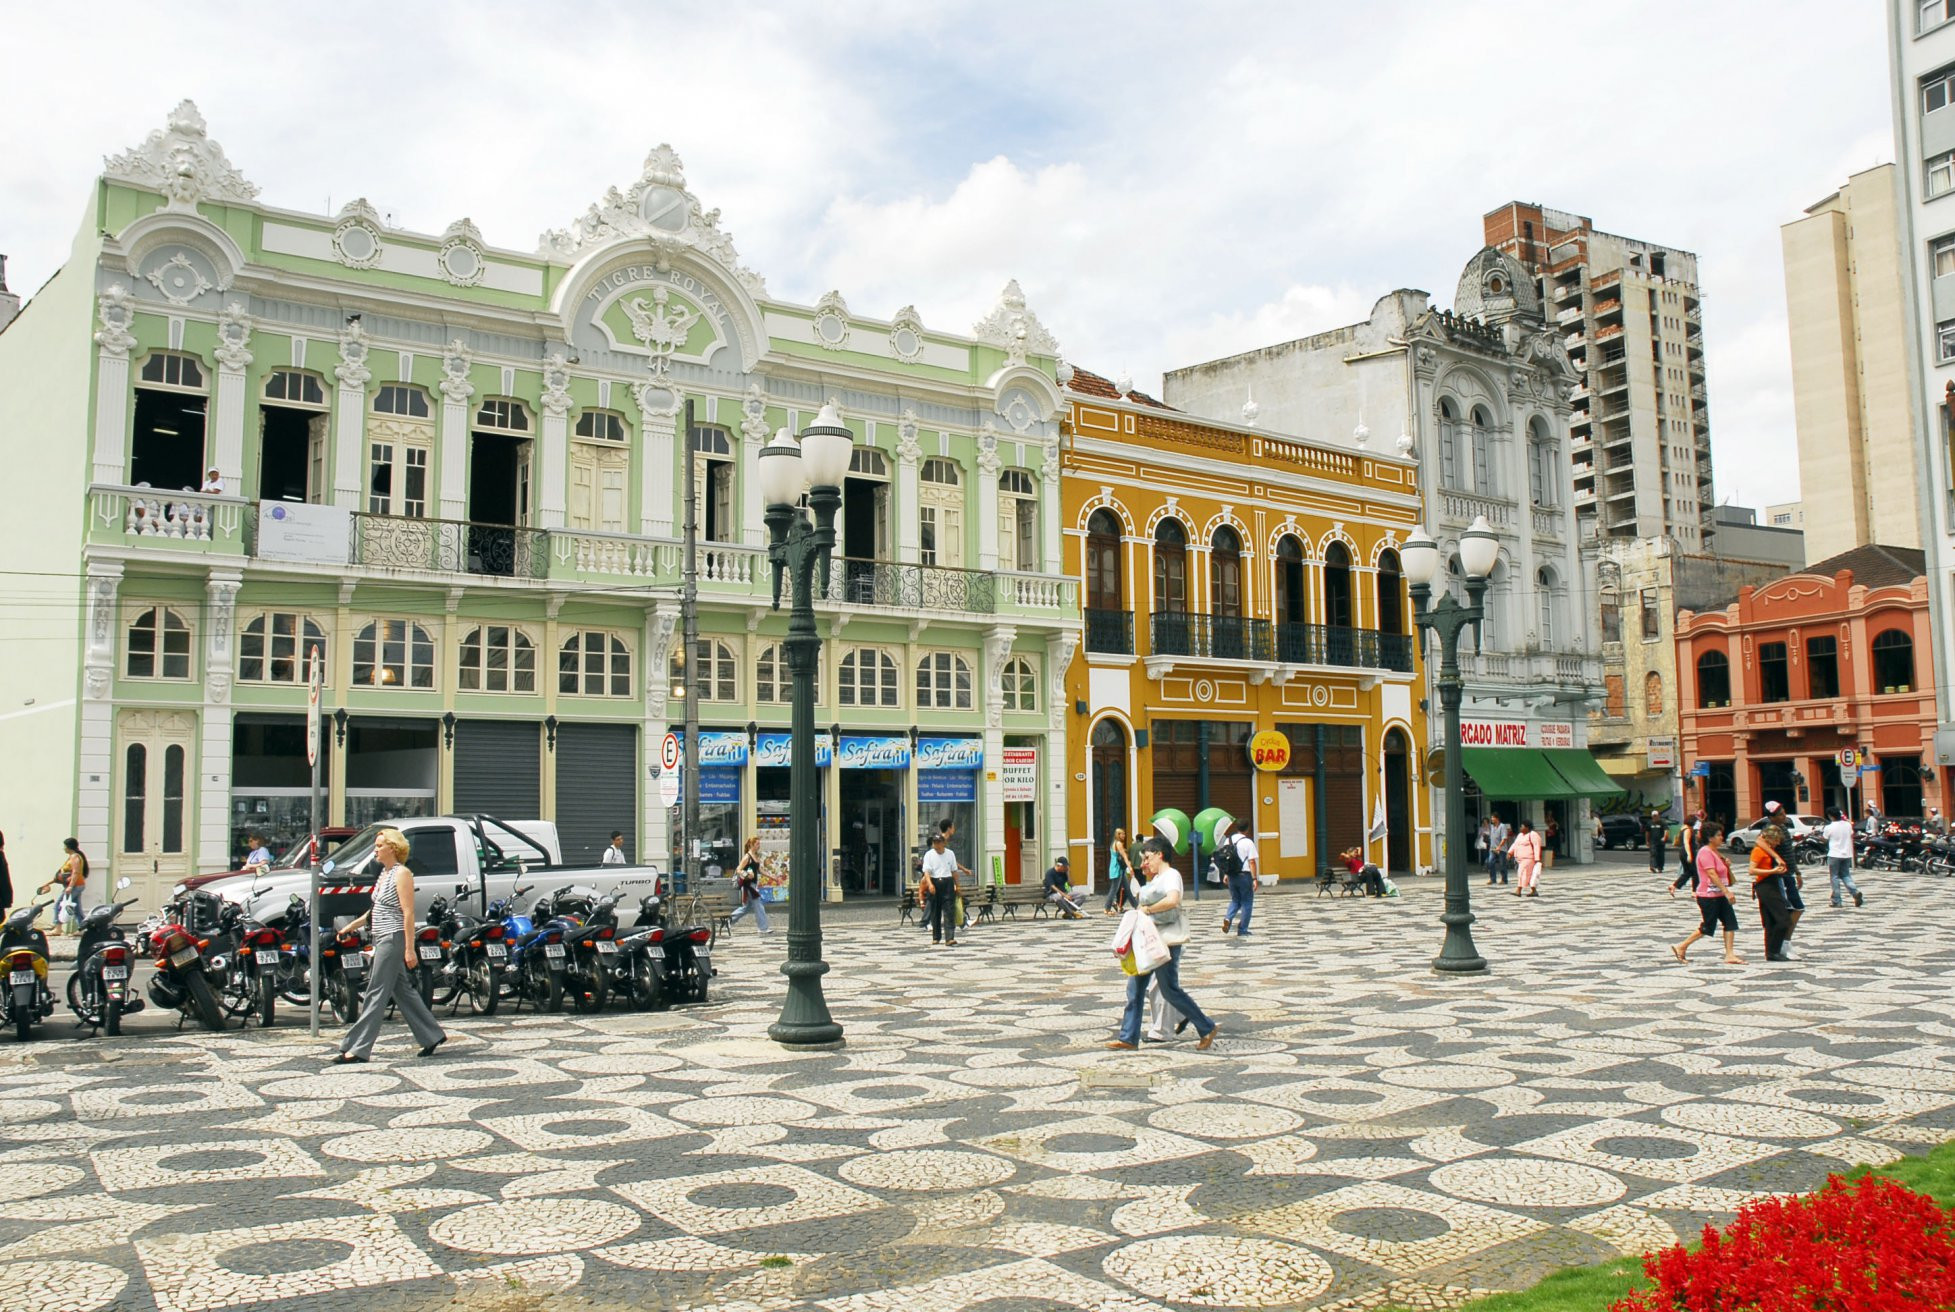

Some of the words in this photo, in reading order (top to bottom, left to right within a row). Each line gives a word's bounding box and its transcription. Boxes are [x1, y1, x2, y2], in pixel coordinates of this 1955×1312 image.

[588, 266, 653, 302] TIGRE
[670, 270, 729, 326] ROYAL
[1461, 723, 1492, 745] RCADO
[1495, 724, 1526, 746] MATRIZ
[666, 741, 673, 763] E
[760, 737, 792, 764] Saf
[843, 741, 894, 766] Safira
[921, 743, 968, 767] Safira
[1255, 748, 1286, 764] BAR
[1845, 751, 1852, 763] E
[1004, 776, 1015, 784] OR
[1017, 776, 1035, 784] KILO
